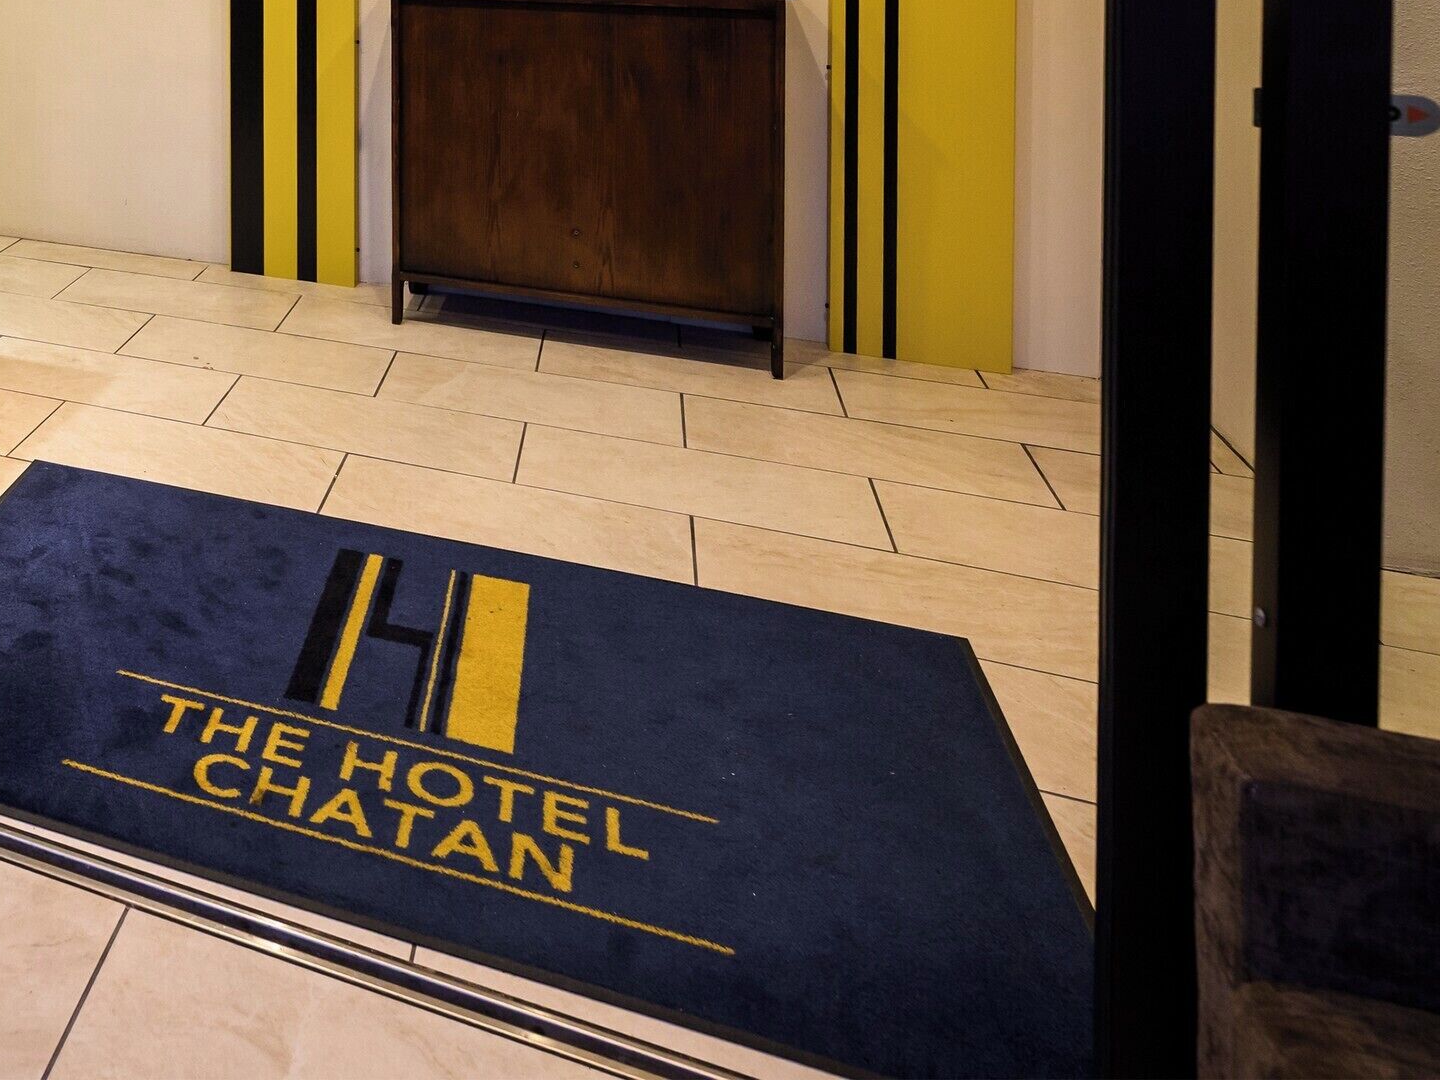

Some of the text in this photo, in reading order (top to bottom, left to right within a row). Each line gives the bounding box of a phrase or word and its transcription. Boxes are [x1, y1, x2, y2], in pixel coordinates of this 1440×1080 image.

[161, 693, 649, 860] THE HOTEL
[193, 753, 575, 893] CHATAN
